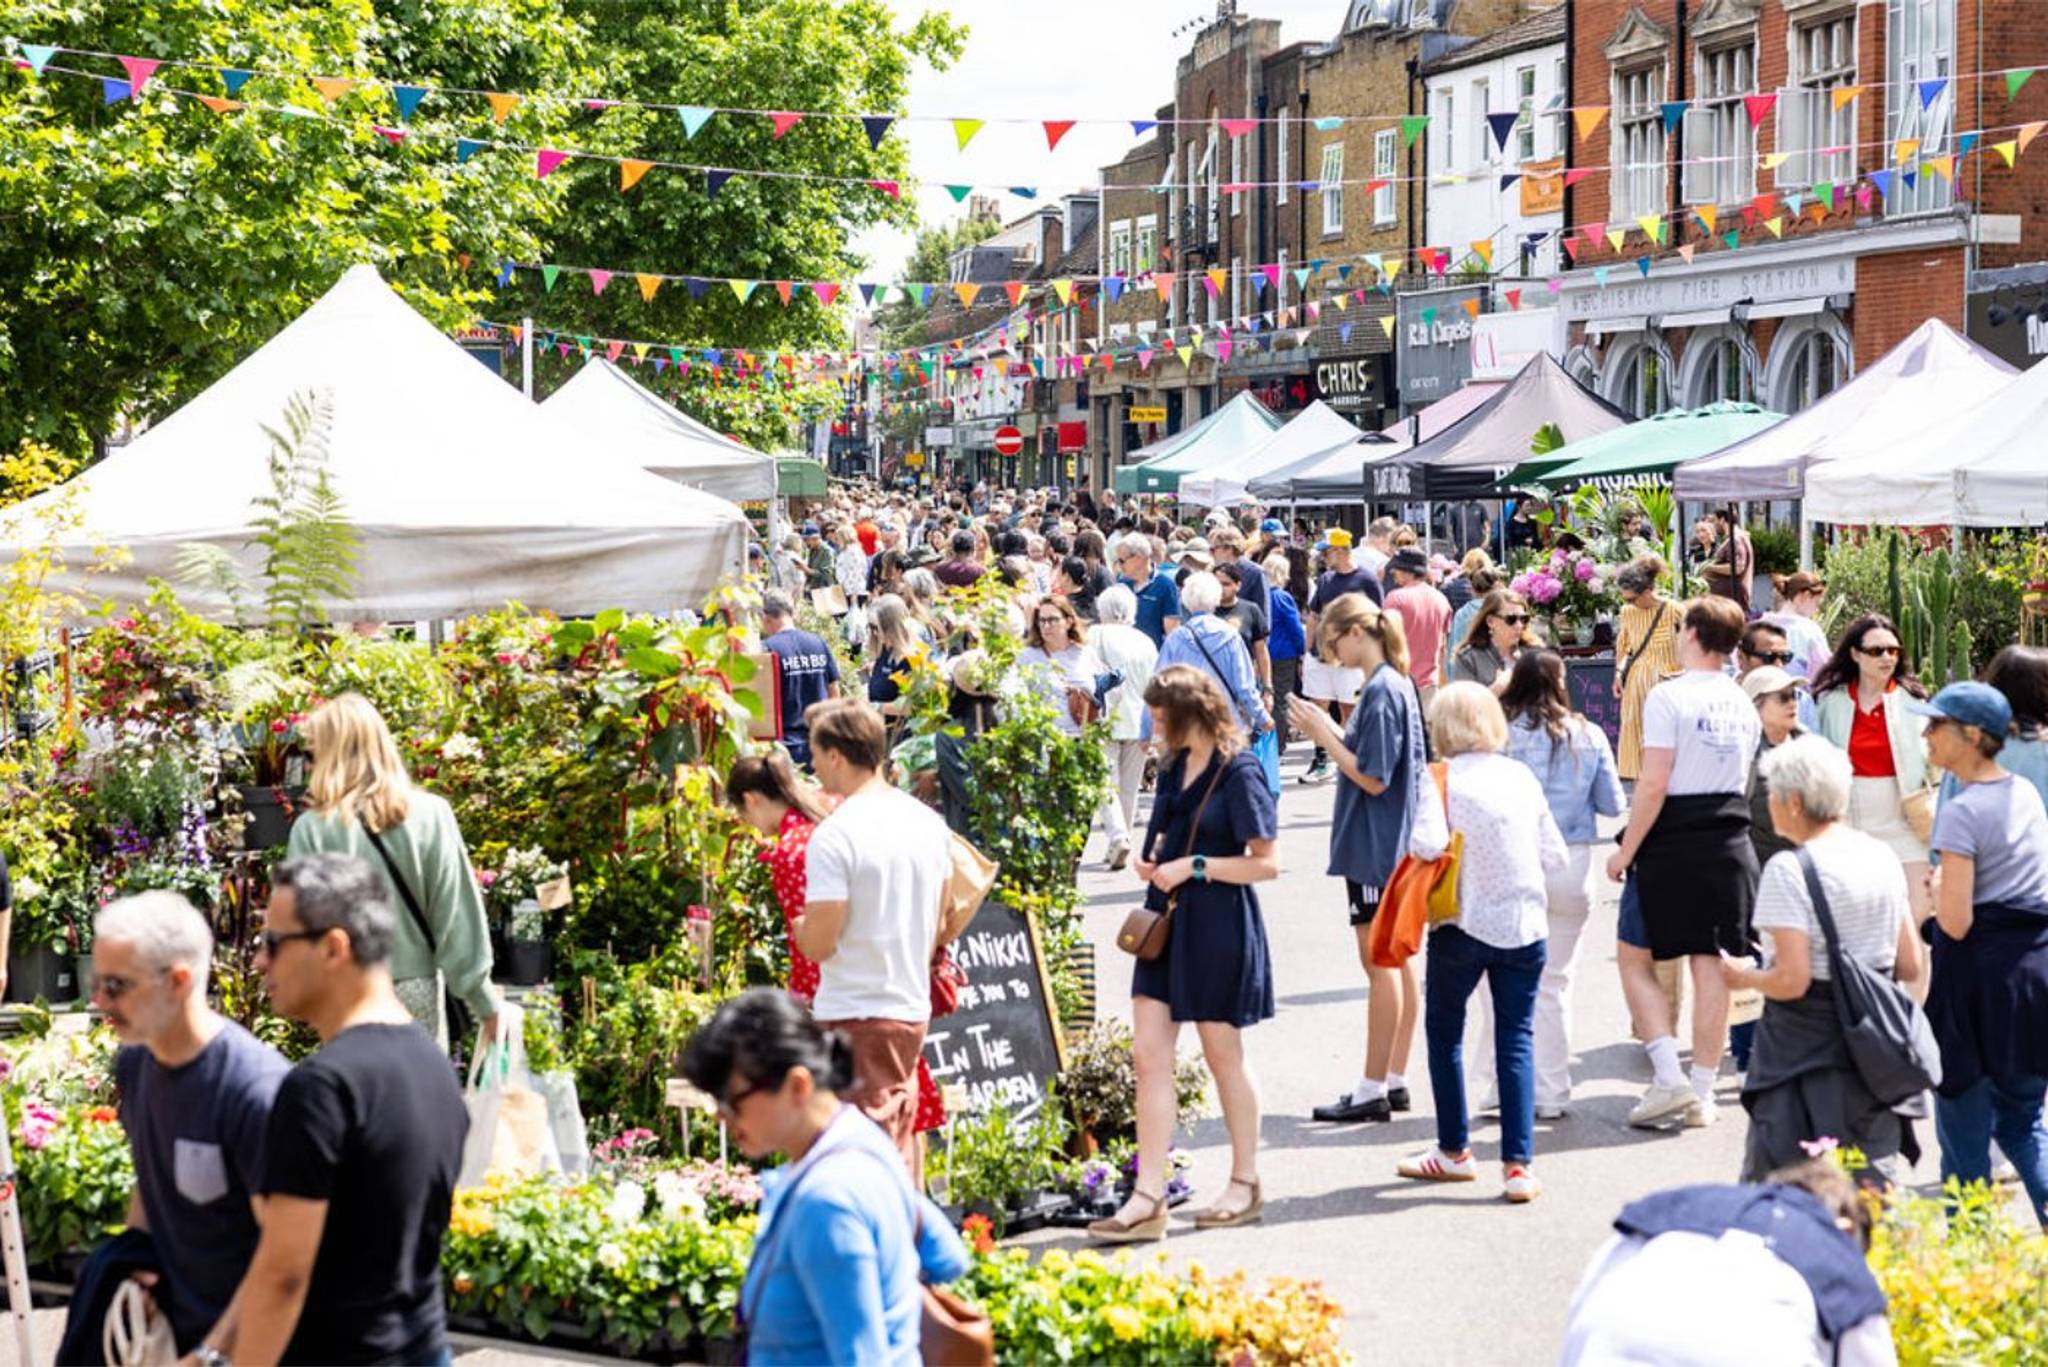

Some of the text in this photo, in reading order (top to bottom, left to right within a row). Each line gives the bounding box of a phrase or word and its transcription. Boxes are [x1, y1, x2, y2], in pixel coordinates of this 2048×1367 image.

[1682, 277, 1720, 303] FIRE
[1742, 263, 1820, 296] STATION
[1317, 360, 1368, 394] CHRIS
[782, 653, 828, 671] HERBS
